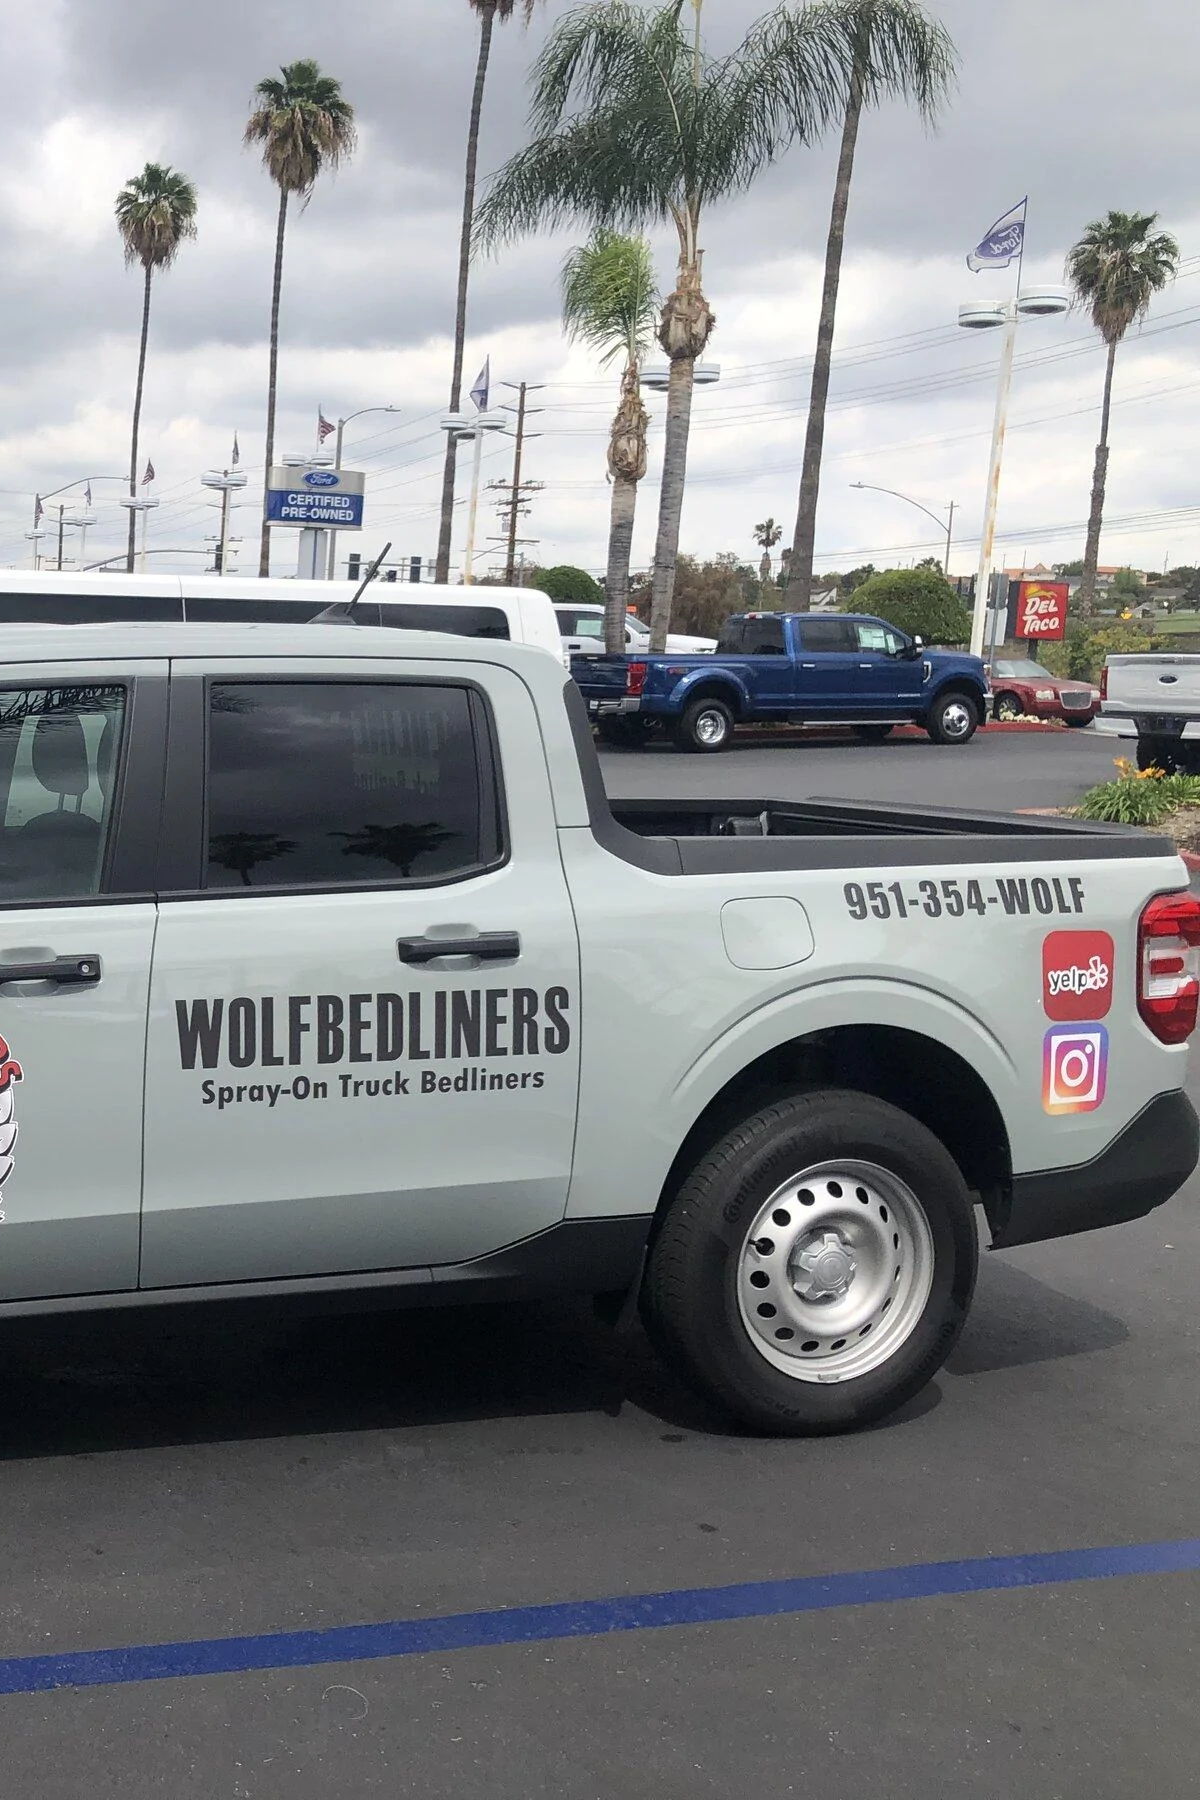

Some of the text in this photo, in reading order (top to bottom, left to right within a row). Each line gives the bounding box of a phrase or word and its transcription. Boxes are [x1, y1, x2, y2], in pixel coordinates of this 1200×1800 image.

[310, 472, 333, 485] Ford
[287, 493, 350, 507] CERTIFIED
[281, 506, 354, 521] PRE-OWNED
[1025, 597, 1058, 615] DEL
[843, 877, 1085, 920] 951-354-WOLF
[1050, 967, 1088, 993] yelp
[175, 985, 571, 1070] WOLFBEDLINERS
[201, 1067, 545, 1110] Spray-On Truck Bedliners
